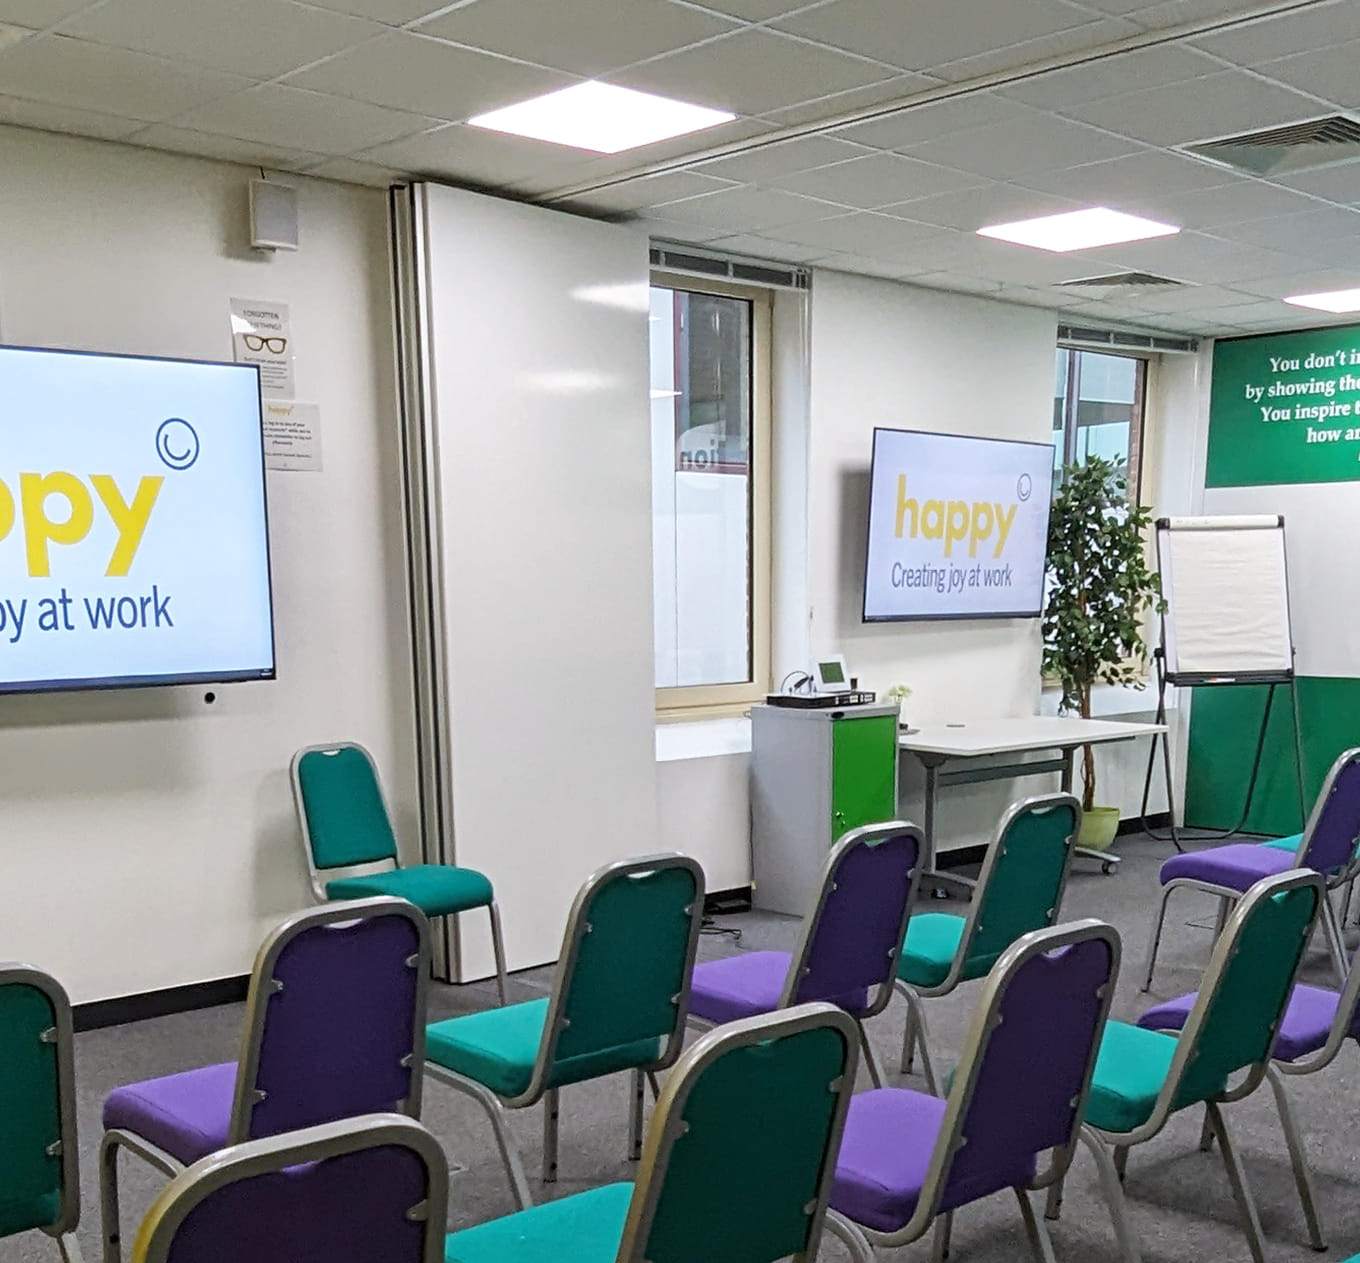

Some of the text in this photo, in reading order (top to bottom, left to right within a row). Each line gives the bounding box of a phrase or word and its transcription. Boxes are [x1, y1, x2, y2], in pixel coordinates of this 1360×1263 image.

[1270, 357, 1300, 372] You
[1304, 350, 1346, 369] don't
[1245, 384, 1264, 403] by
[1267, 377, 1336, 397] showing
[1260, 406, 1290, 422] You
[1295, 401, 1351, 422] inspire
[1306, 427, 1342, 443] how
[895, 474, 1018, 559] happy
[891, 562, 1012, 593] Creating joy at work
[37, 588, 75, 631] at
[83, 584, 175, 630] work
